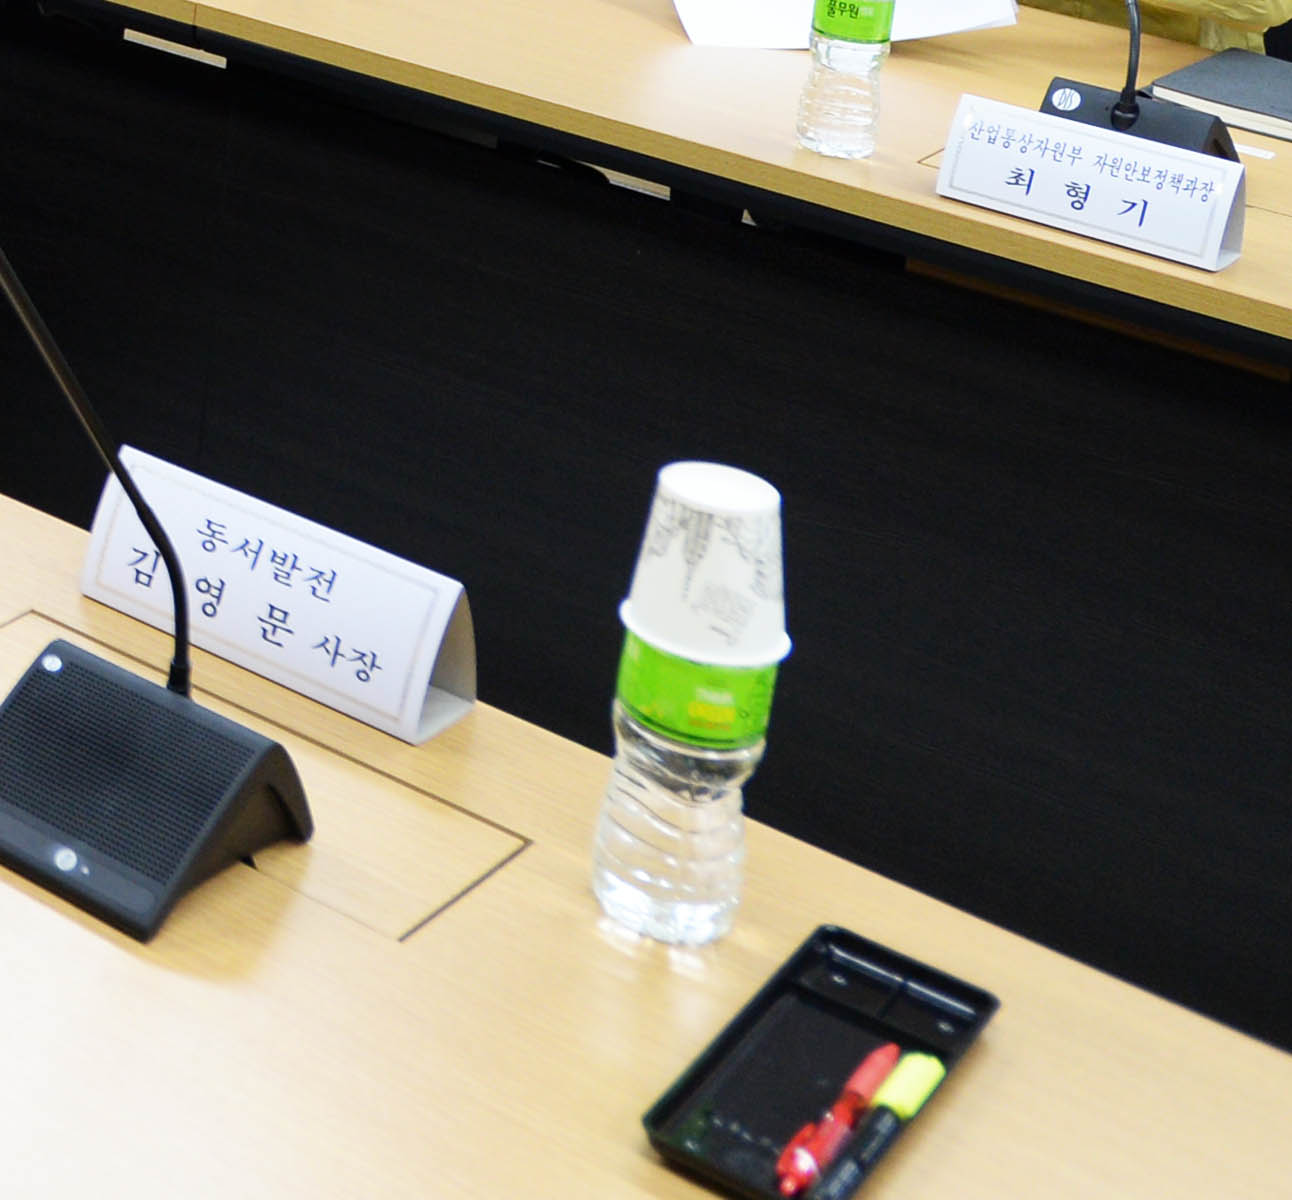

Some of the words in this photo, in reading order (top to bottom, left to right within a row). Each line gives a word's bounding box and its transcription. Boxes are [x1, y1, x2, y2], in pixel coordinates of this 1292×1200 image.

[826, 0, 860, 19] 풀무원
[966, 120, 1084, 168] 산업통상자원부
[1092, 153, 1217, 204] 자원안보정책과장
[1004, 167, 1036, 197] 최
[1063, 180, 1092, 212] 형
[1117, 198, 1150, 229] 기
[196, 517, 339, 604] 동서발전
[127, 546, 160, 590] 김
[194, 575, 227, 619] 영
[256, 602, 296, 649] 문
[312, 634, 384, 684] 사장
